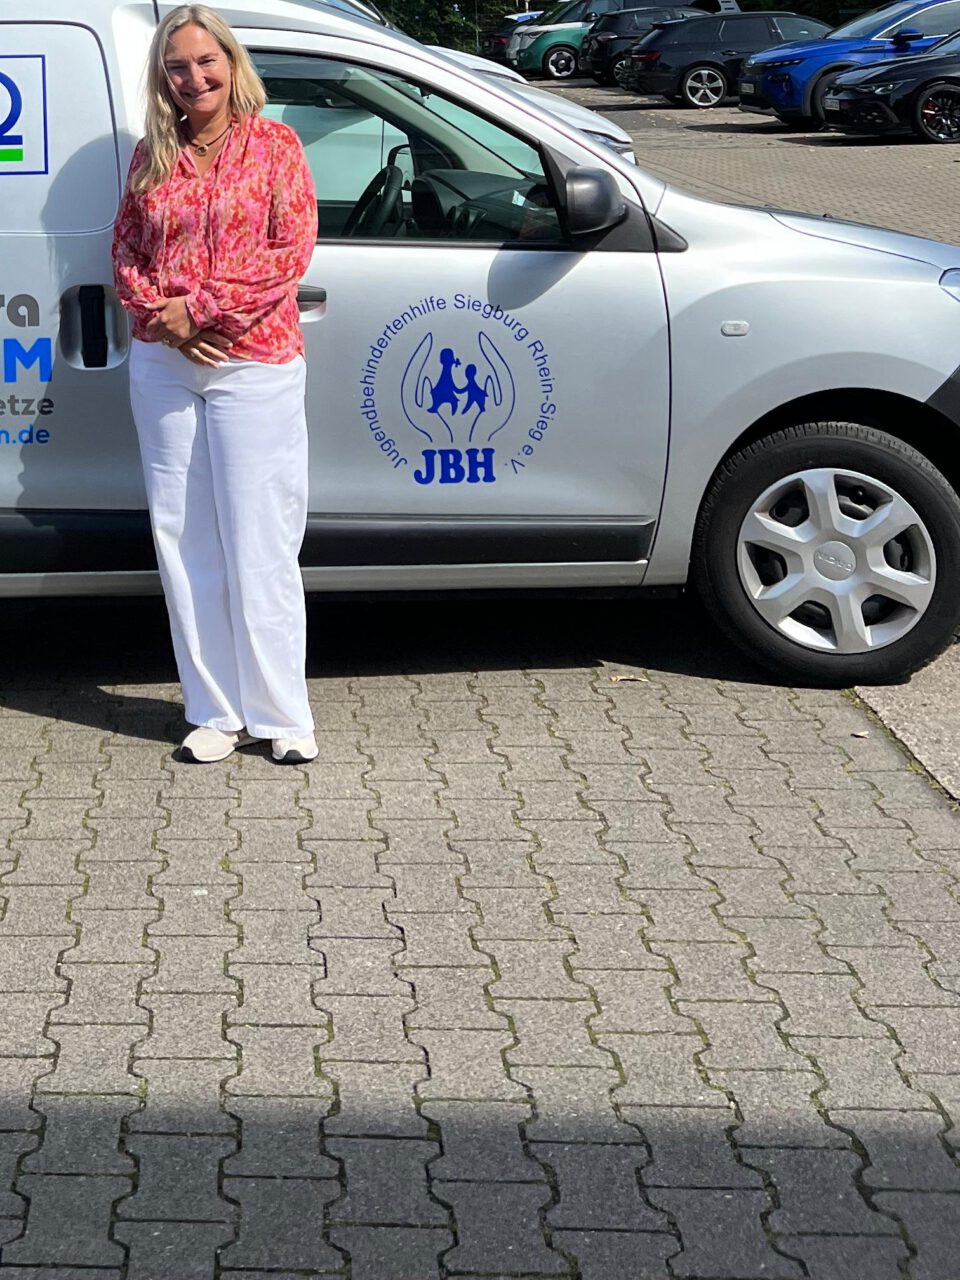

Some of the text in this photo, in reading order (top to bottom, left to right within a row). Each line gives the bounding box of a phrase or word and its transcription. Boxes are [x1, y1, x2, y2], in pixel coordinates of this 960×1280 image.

[359, 295, 447, 469] Jugendbehindertenhilfe
[454, 293, 529, 342] Siegburg
[527, 339, 557, 442] Rhein-Sieg
[414, 448, 496, 485] JBH
